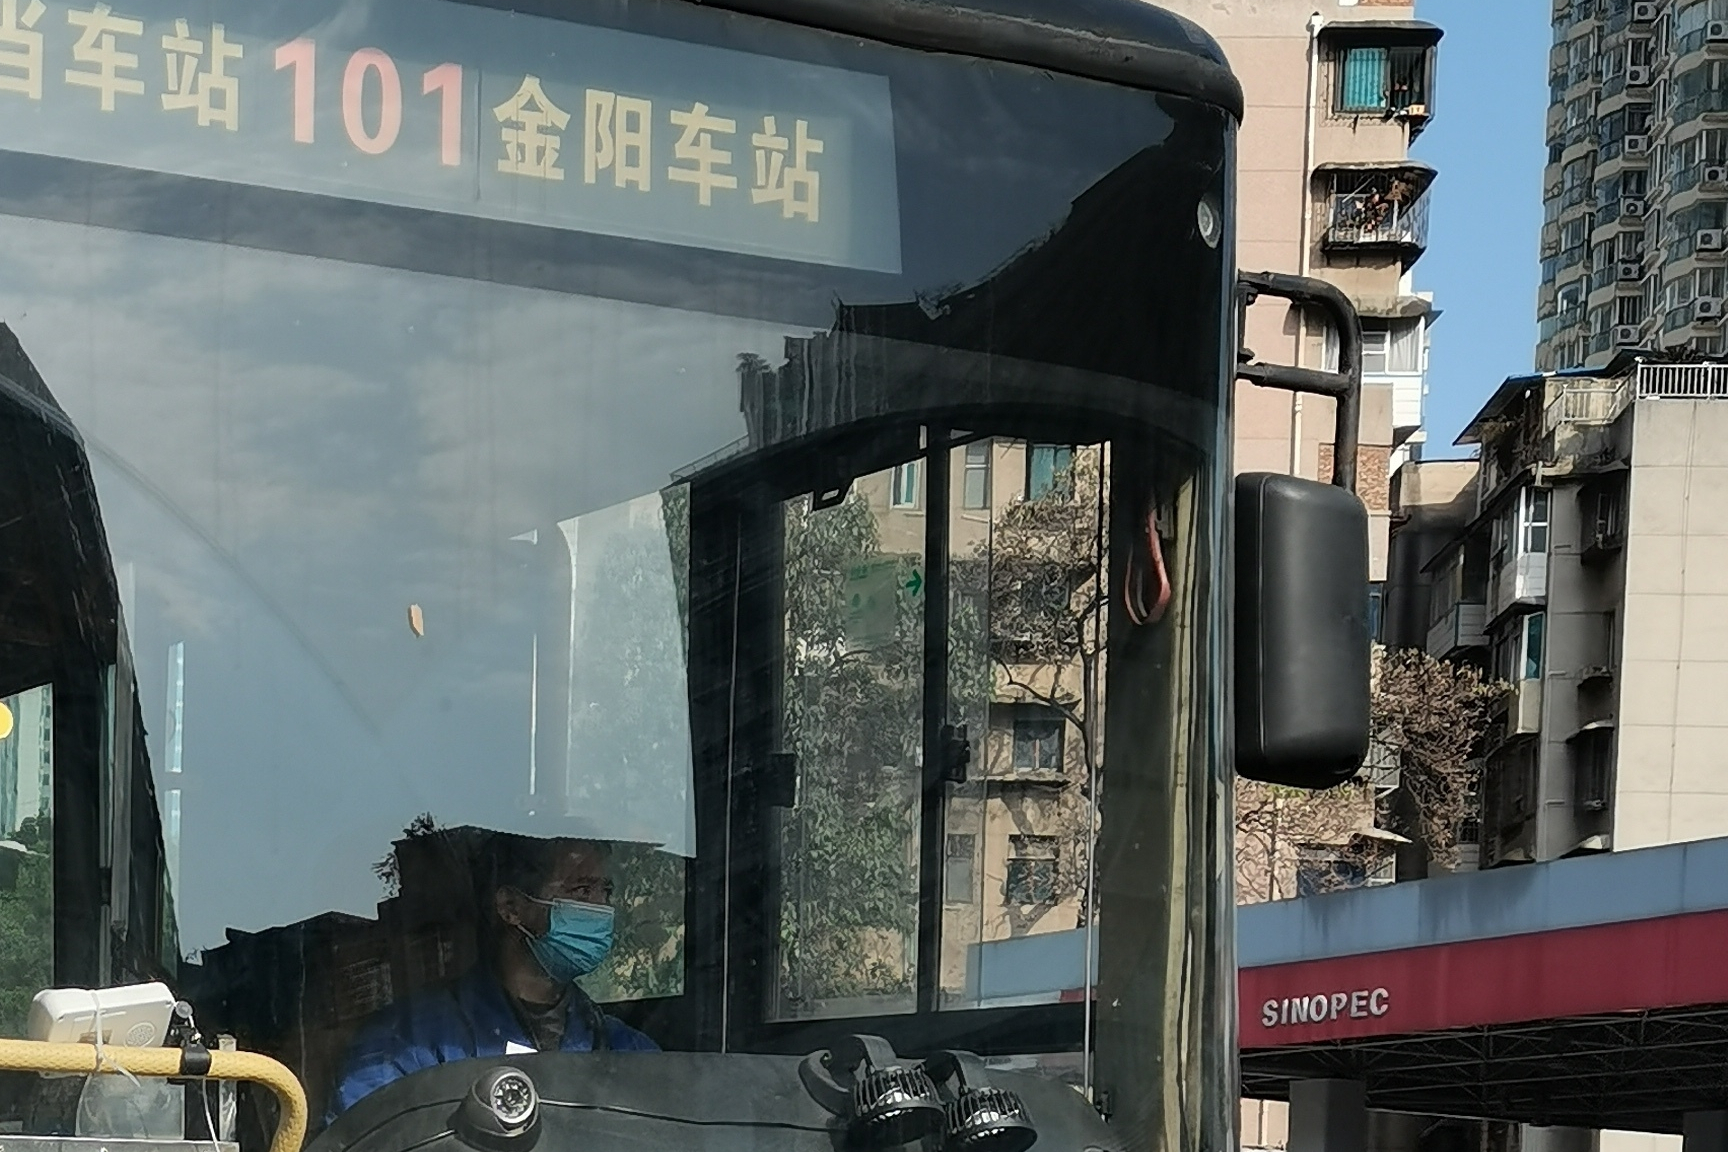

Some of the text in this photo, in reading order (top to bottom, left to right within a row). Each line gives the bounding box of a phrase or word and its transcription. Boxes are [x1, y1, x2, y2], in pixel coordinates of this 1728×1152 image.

[275, 37, 462, 167] 101
[492, 73, 824, 223] 金阳车站
[1261, 987, 1390, 1027] SINOPEC
